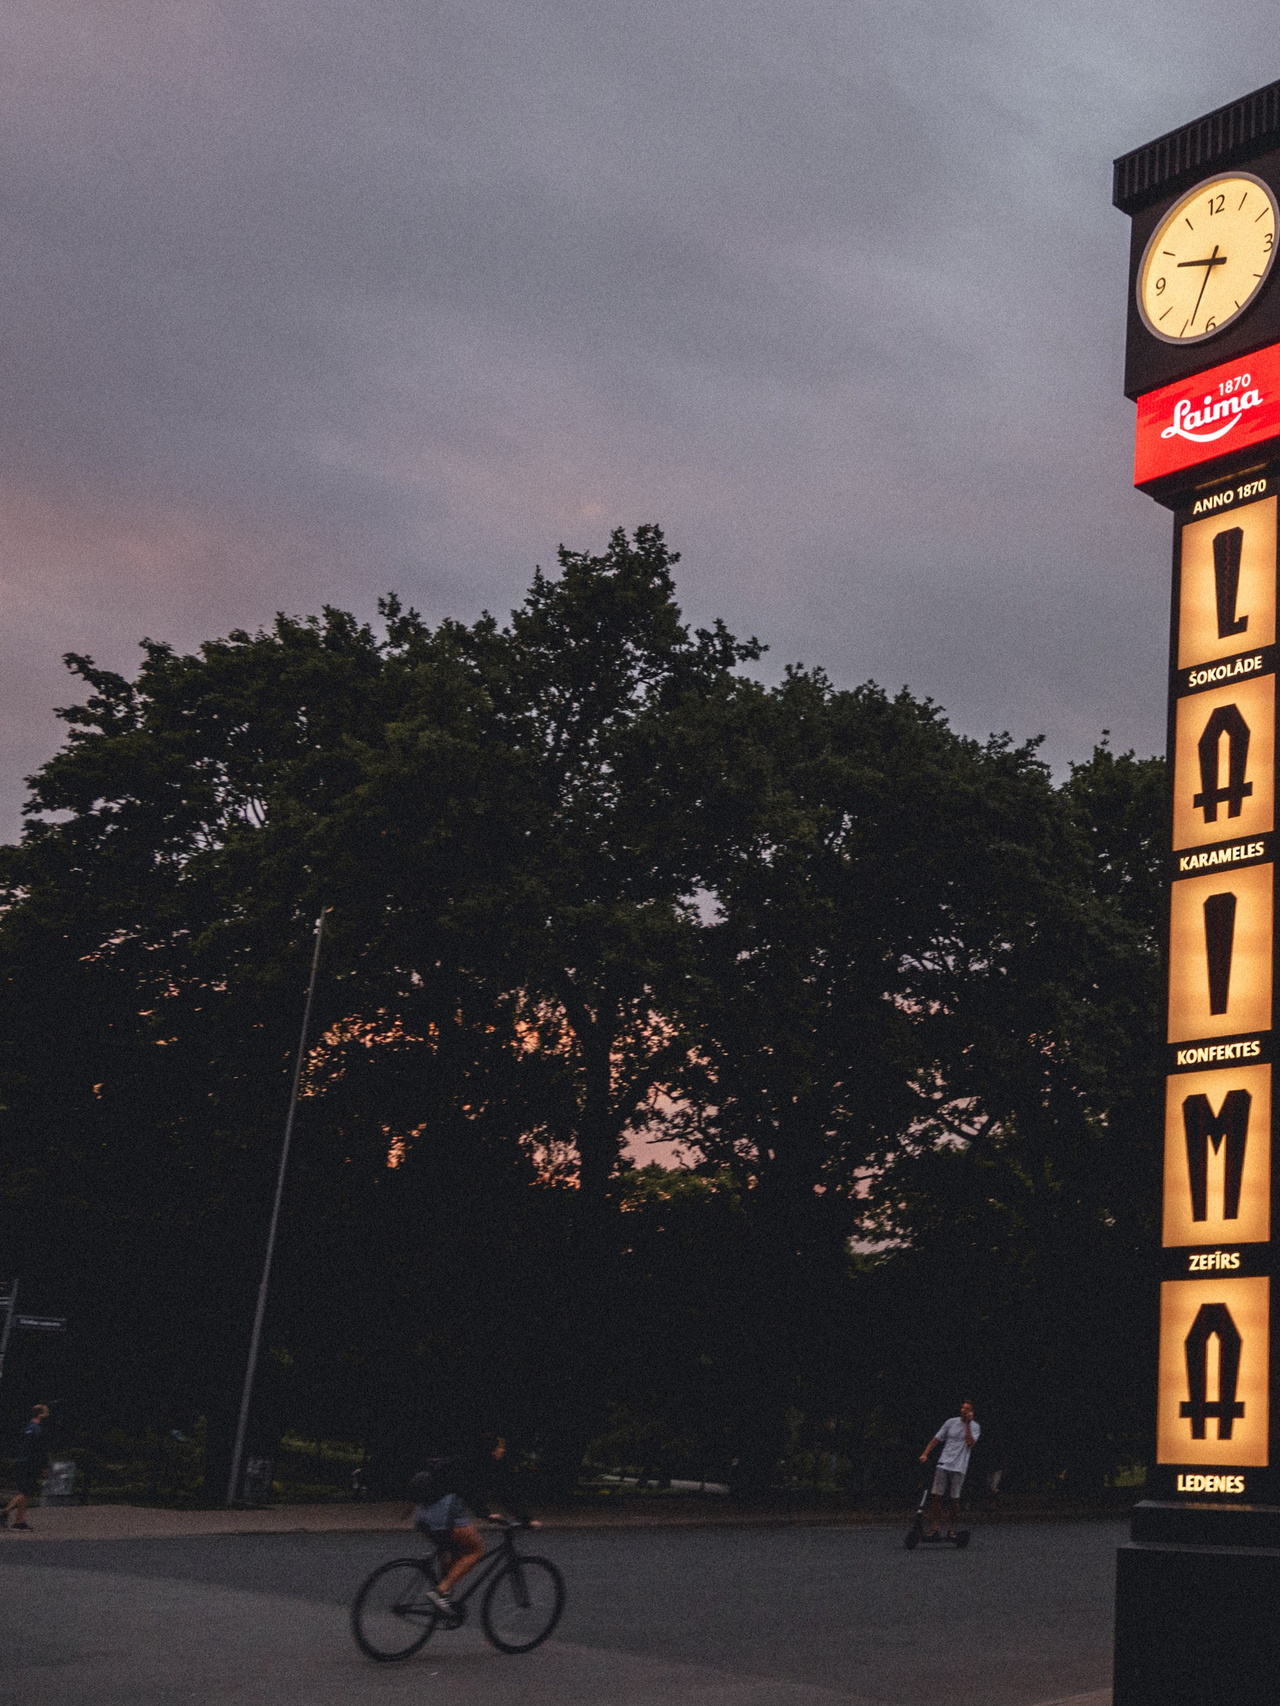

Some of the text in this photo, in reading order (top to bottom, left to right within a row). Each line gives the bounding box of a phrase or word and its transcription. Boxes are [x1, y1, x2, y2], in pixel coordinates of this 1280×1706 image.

[1207, 194, 1226, 216] 12
[1263, 232, 1274, 252] 3
[1155, 277, 1166, 296] 9
[1205, 315, 1216, 333] 6
[1218, 373, 1251, 396] 1870
[1160, 388, 1264, 443] Laima
[1192, 478, 1268, 515] ANNO 1870
[1188, 655, 1263, 688] ŠOKOLĀDE
[1179, 841, 1265, 872] KARAMELES
[1176, 1040, 1261, 1066] KONFEKTES
[1188, 1251, 1241, 1271] ZEFĪRS
[1177, 1473, 1246, 1494] LEDENES
